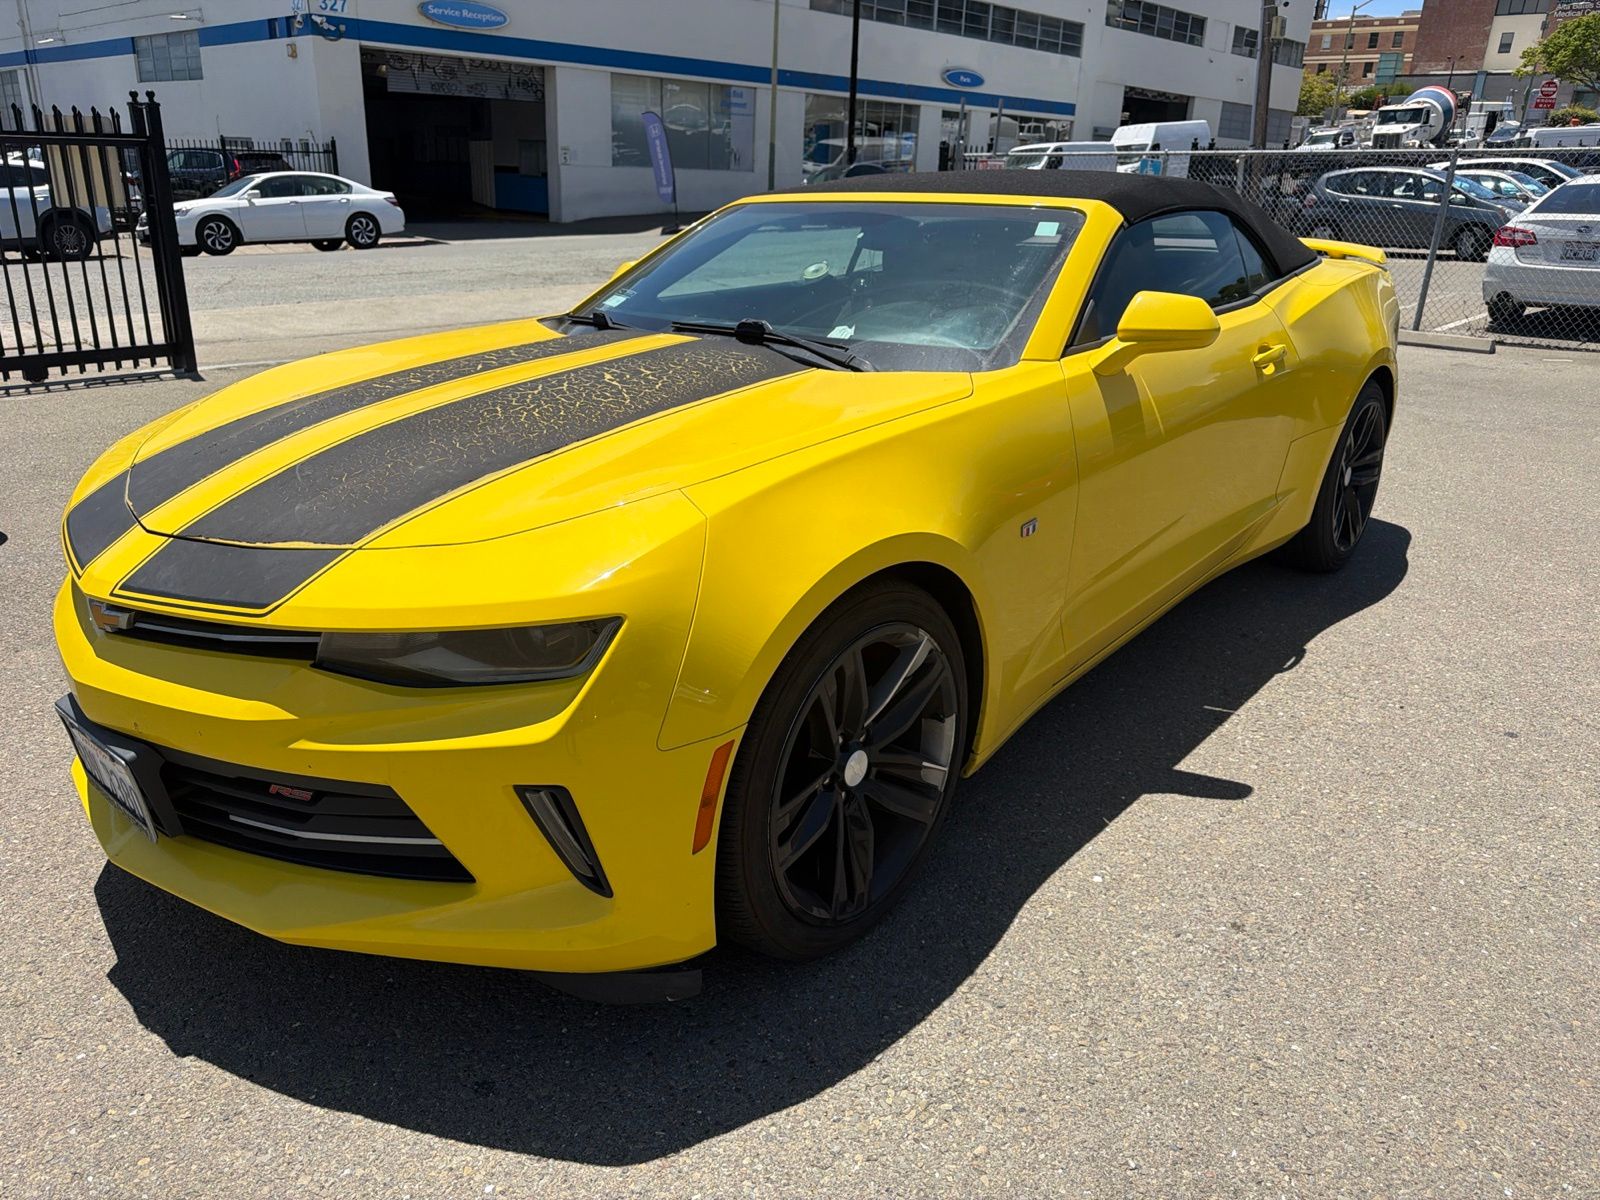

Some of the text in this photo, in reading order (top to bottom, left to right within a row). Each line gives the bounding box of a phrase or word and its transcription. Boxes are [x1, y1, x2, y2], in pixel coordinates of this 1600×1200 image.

[319, 0, 347, 12] 327
[428, 4, 505, 22] Service Reception
[1553, 10, 1584, 18] Medical
[269, 784, 313, 801] RS
